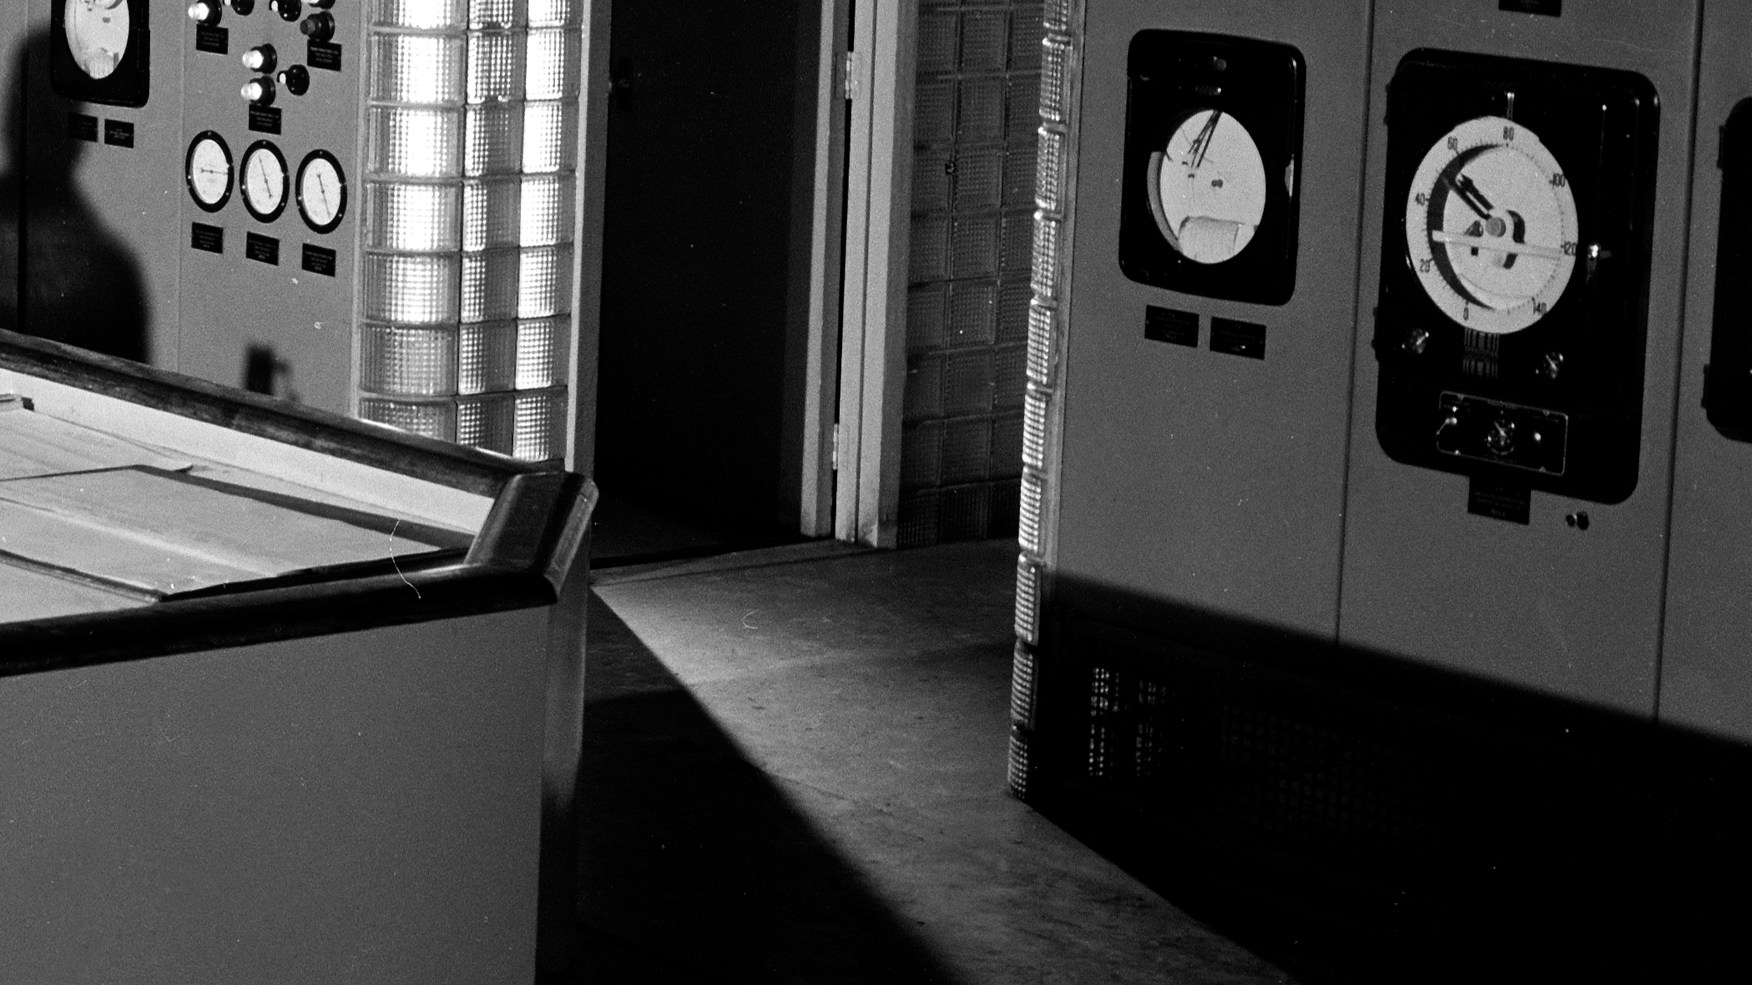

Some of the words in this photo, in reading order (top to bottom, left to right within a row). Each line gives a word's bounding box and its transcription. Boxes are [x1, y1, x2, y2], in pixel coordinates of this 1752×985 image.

[1502, 127, 1514, 140] 80
[1447, 136, 1458, 149] 60
[1552, 173, 1566, 187] 100
[1414, 193, 1425, 206] 40
[1564, 242, 1577, 256] 120
[1419, 259, 1430, 273] 20
[1462, 306, 1469, 320] 0
[1532, 301, 1547, 314] 140
